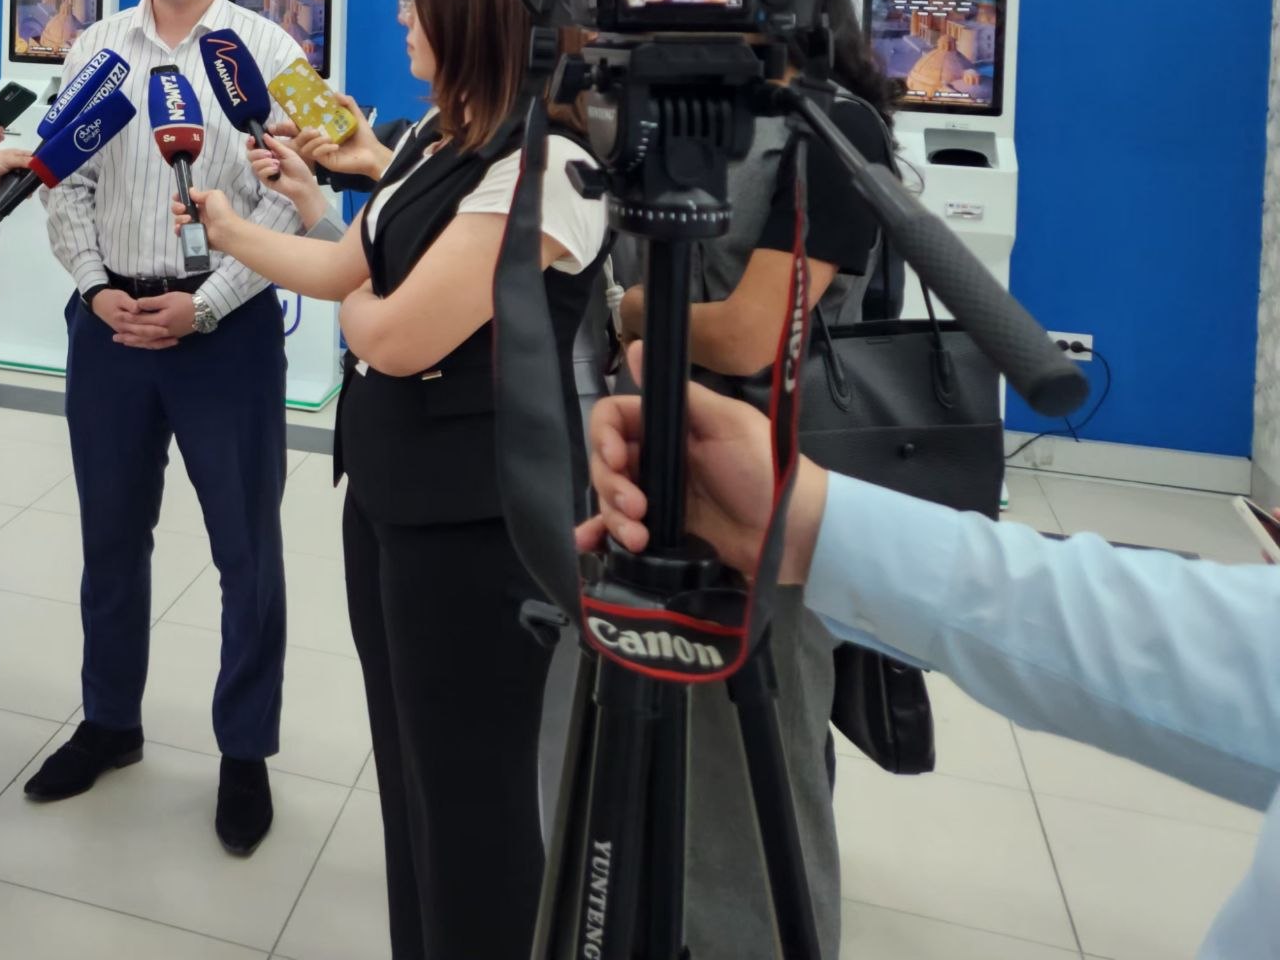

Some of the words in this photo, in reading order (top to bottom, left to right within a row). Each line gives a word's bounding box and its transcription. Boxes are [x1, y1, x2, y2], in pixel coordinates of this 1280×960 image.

[113, 66, 126, 82] 24
[214, 59, 240, 106] MAHALLA
[587, 616, 723, 667] Canon
